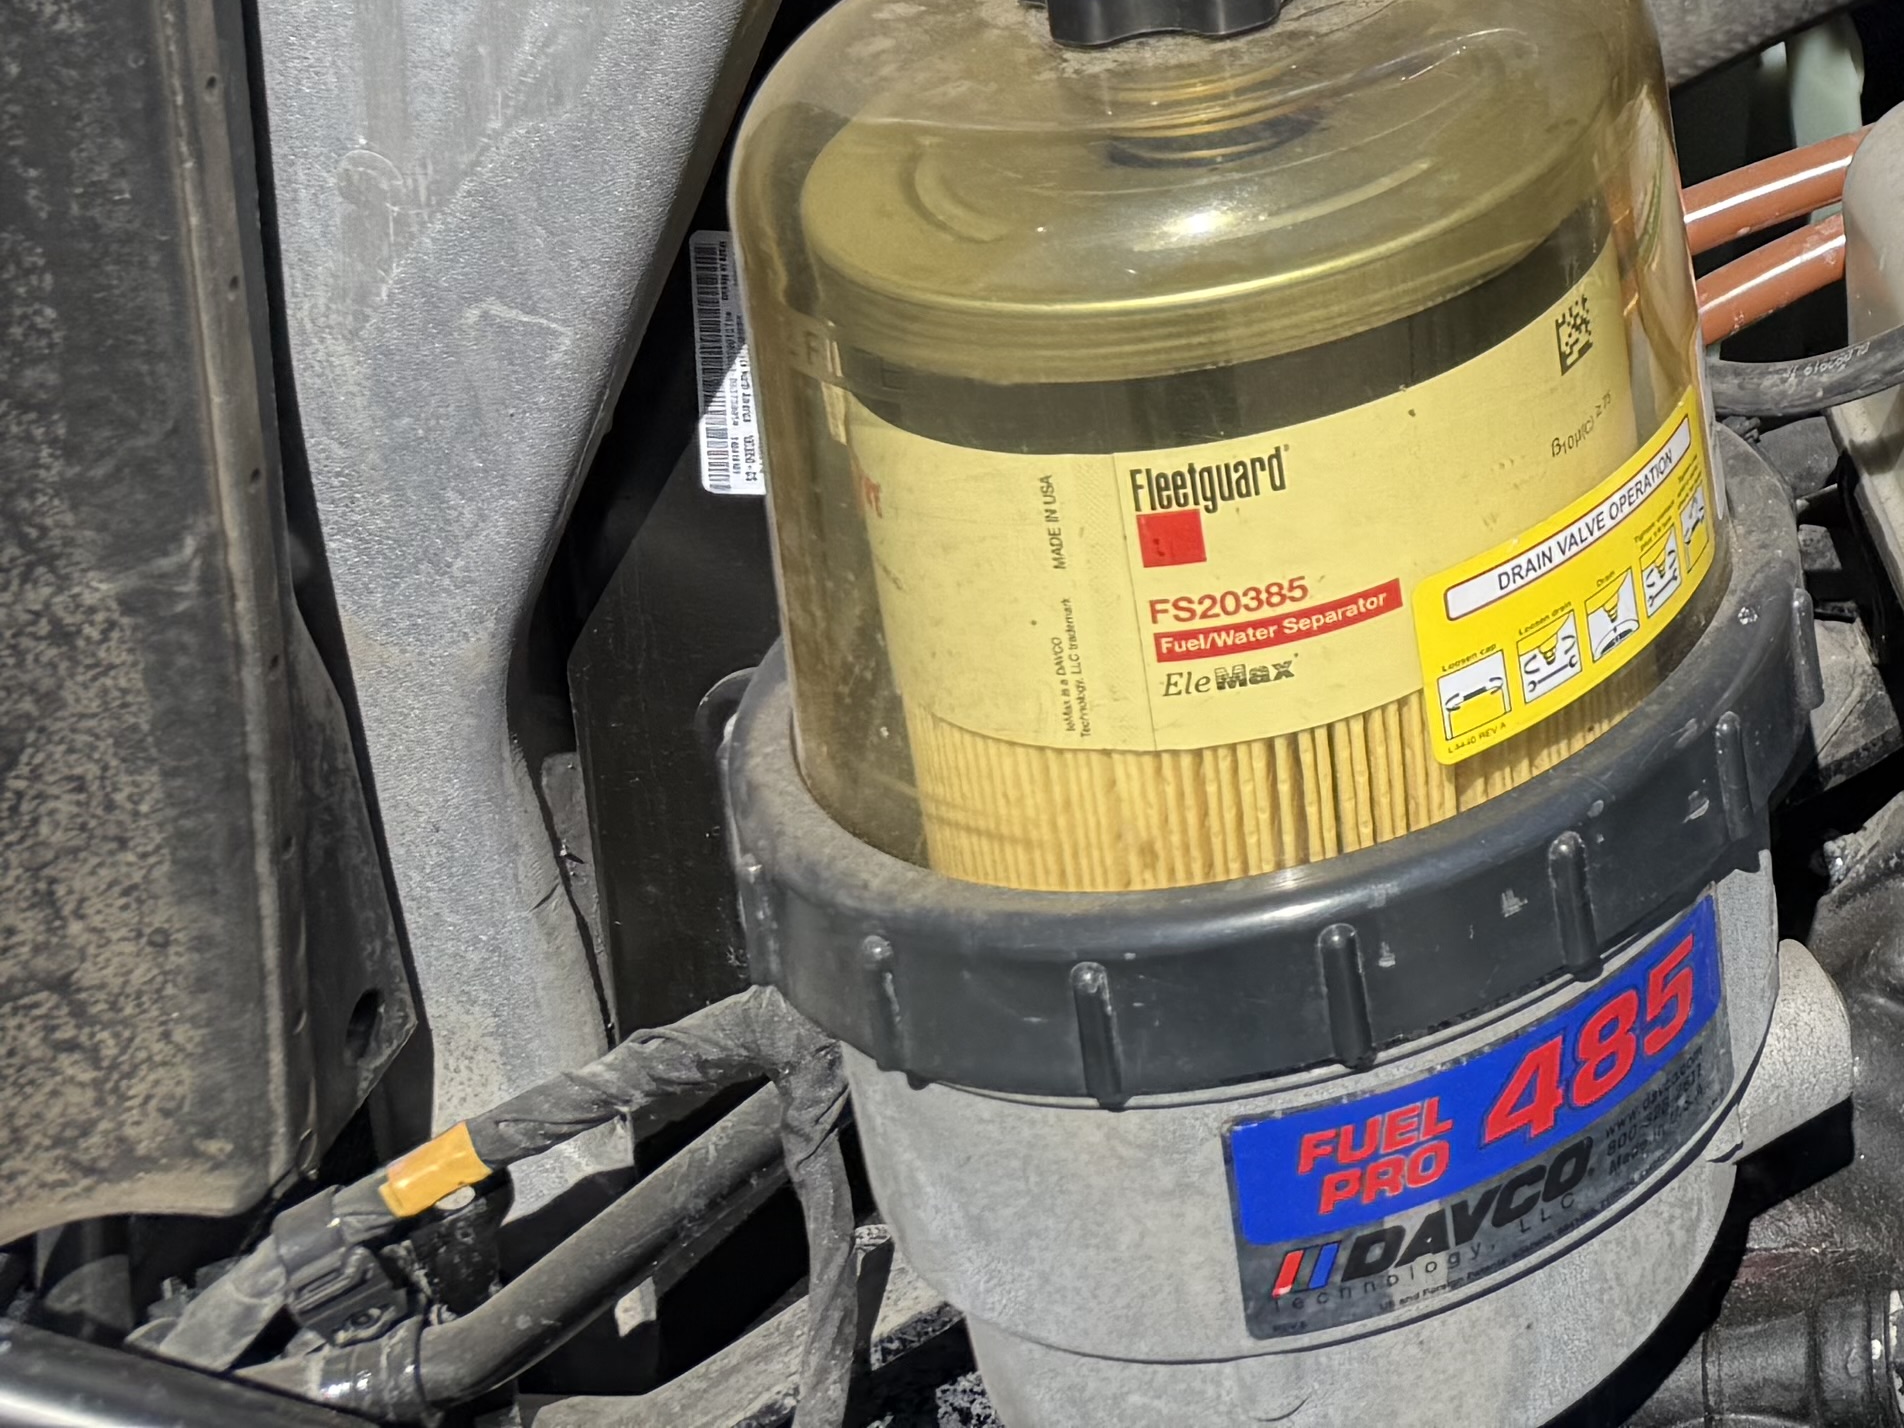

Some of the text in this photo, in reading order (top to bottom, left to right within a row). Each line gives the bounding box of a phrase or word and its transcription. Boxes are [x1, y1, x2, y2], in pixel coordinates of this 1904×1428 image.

[1129, 445, 1287, 514] Fleetguard
[1040, 474, 1068, 570] MADE IN USA
[1497, 544, 1554, 592] DRAIN
[1556, 509, 1607, 560] VALVE
[1608, 446, 1674, 523] OPERATION
[1148, 575, 1310, 624] FS20385
[1595, 568, 1616, 588] Drain
[1061, 598, 1078, 652] trademark
[1159, 589, 1388, 655] Fuel/Water Separator
[1518, 600, 1573, 637] Loosen drain
[1051, 636, 1067, 678] DAVCO
[1070, 653, 1082, 676] LLC
[1440, 641, 1498, 673] Loosen cap
[1296, 933, 1696, 1176] FUEL 485
[1318, 1140, 1452, 1216] PRO
[1341, 1135, 1594, 1283] DAVCO
[1274, 1232, 1498, 1313] Technology,
[1518, 1190, 1577, 1234] LLC
